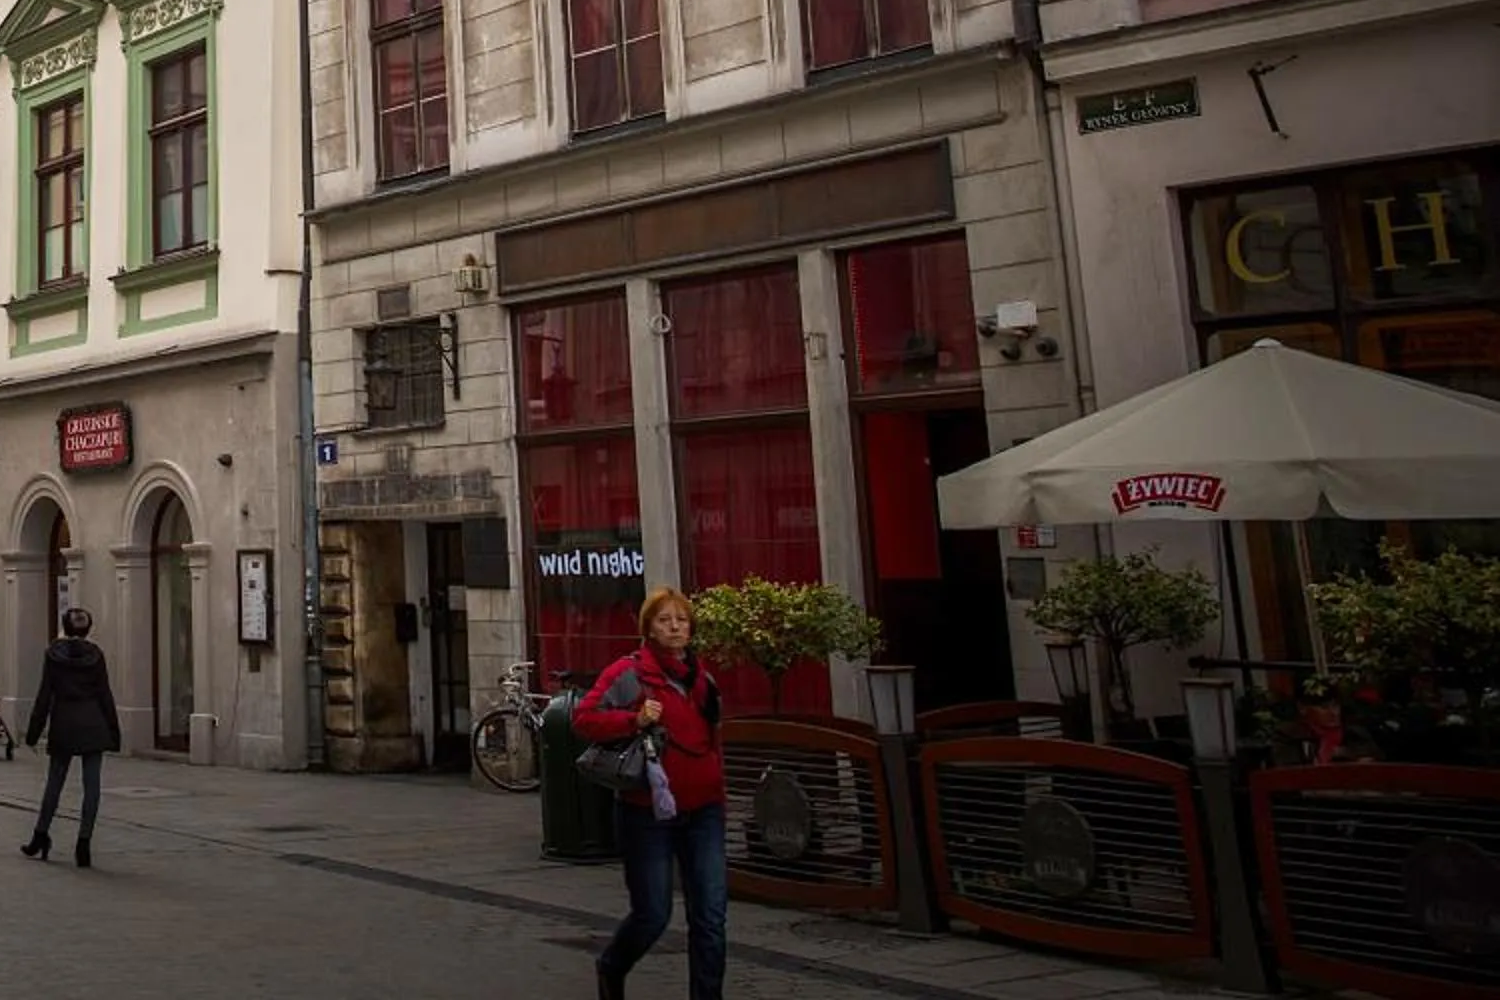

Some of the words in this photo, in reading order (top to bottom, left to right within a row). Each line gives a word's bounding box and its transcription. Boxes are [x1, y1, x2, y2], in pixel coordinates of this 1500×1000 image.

[323, 445, 332, 461] 1
[1125, 475, 1213, 502] ŻYWIEC
[539, 548, 582, 577] wild
[587, 546, 645, 579] night
